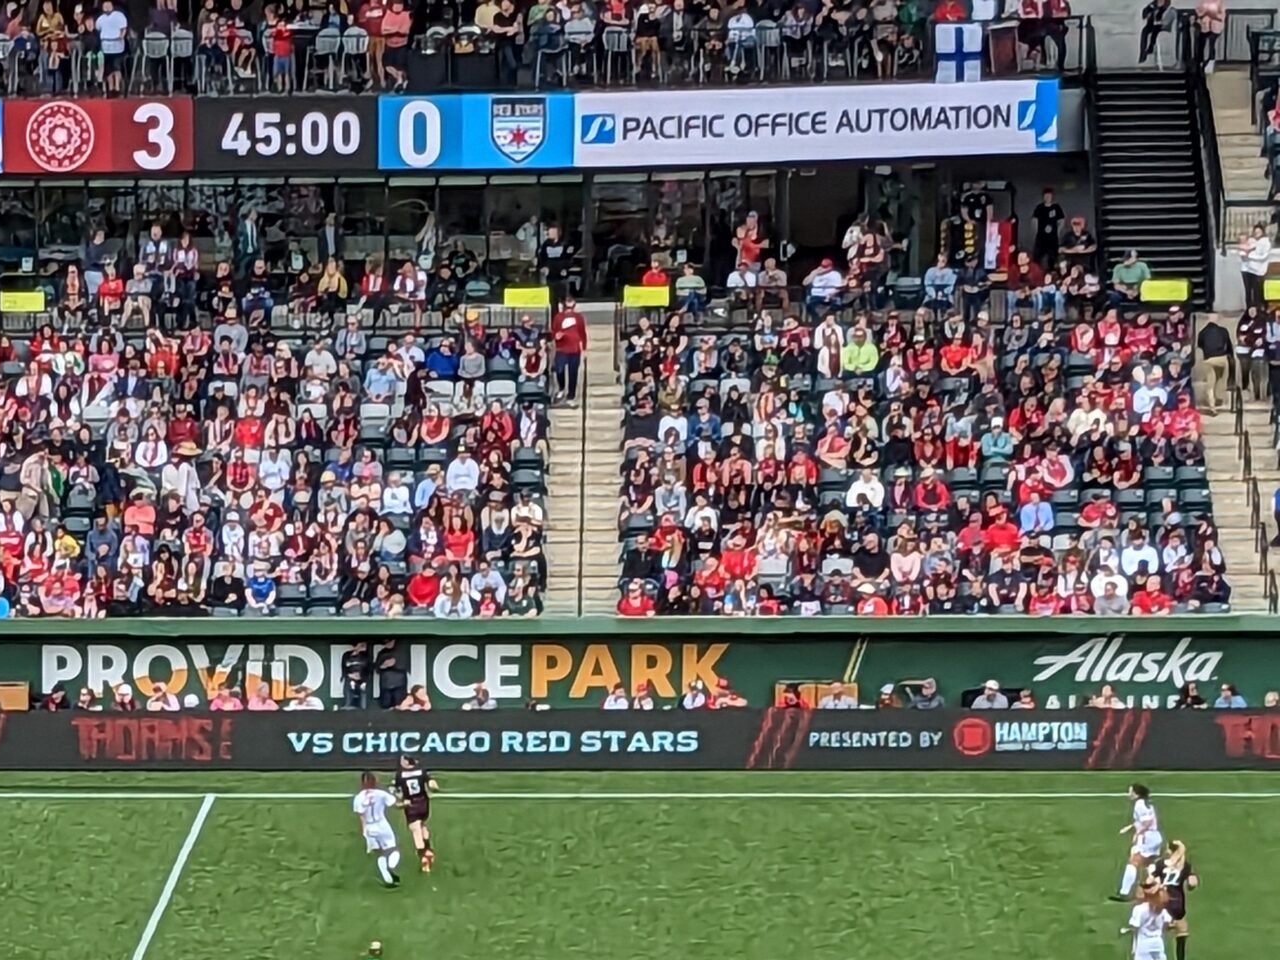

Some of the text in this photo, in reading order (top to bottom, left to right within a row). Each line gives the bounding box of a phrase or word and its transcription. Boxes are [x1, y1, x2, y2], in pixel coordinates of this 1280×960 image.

[132, 102, 176, 171] 3
[221, 111, 361, 156] 45:00
[398, 100, 442, 167] 0
[622, 104, 1011, 141] PACIFIC OFFICE AUTOMATION
[531, 643, 730, 698] PARK
[1032, 637, 1223, 688] Alaska
[287, 731, 699, 753] VS CHICAGO RED STARS
[809, 731, 943, 748] PRESENTED BY
[995, 722, 1087, 742] HAMPTON
